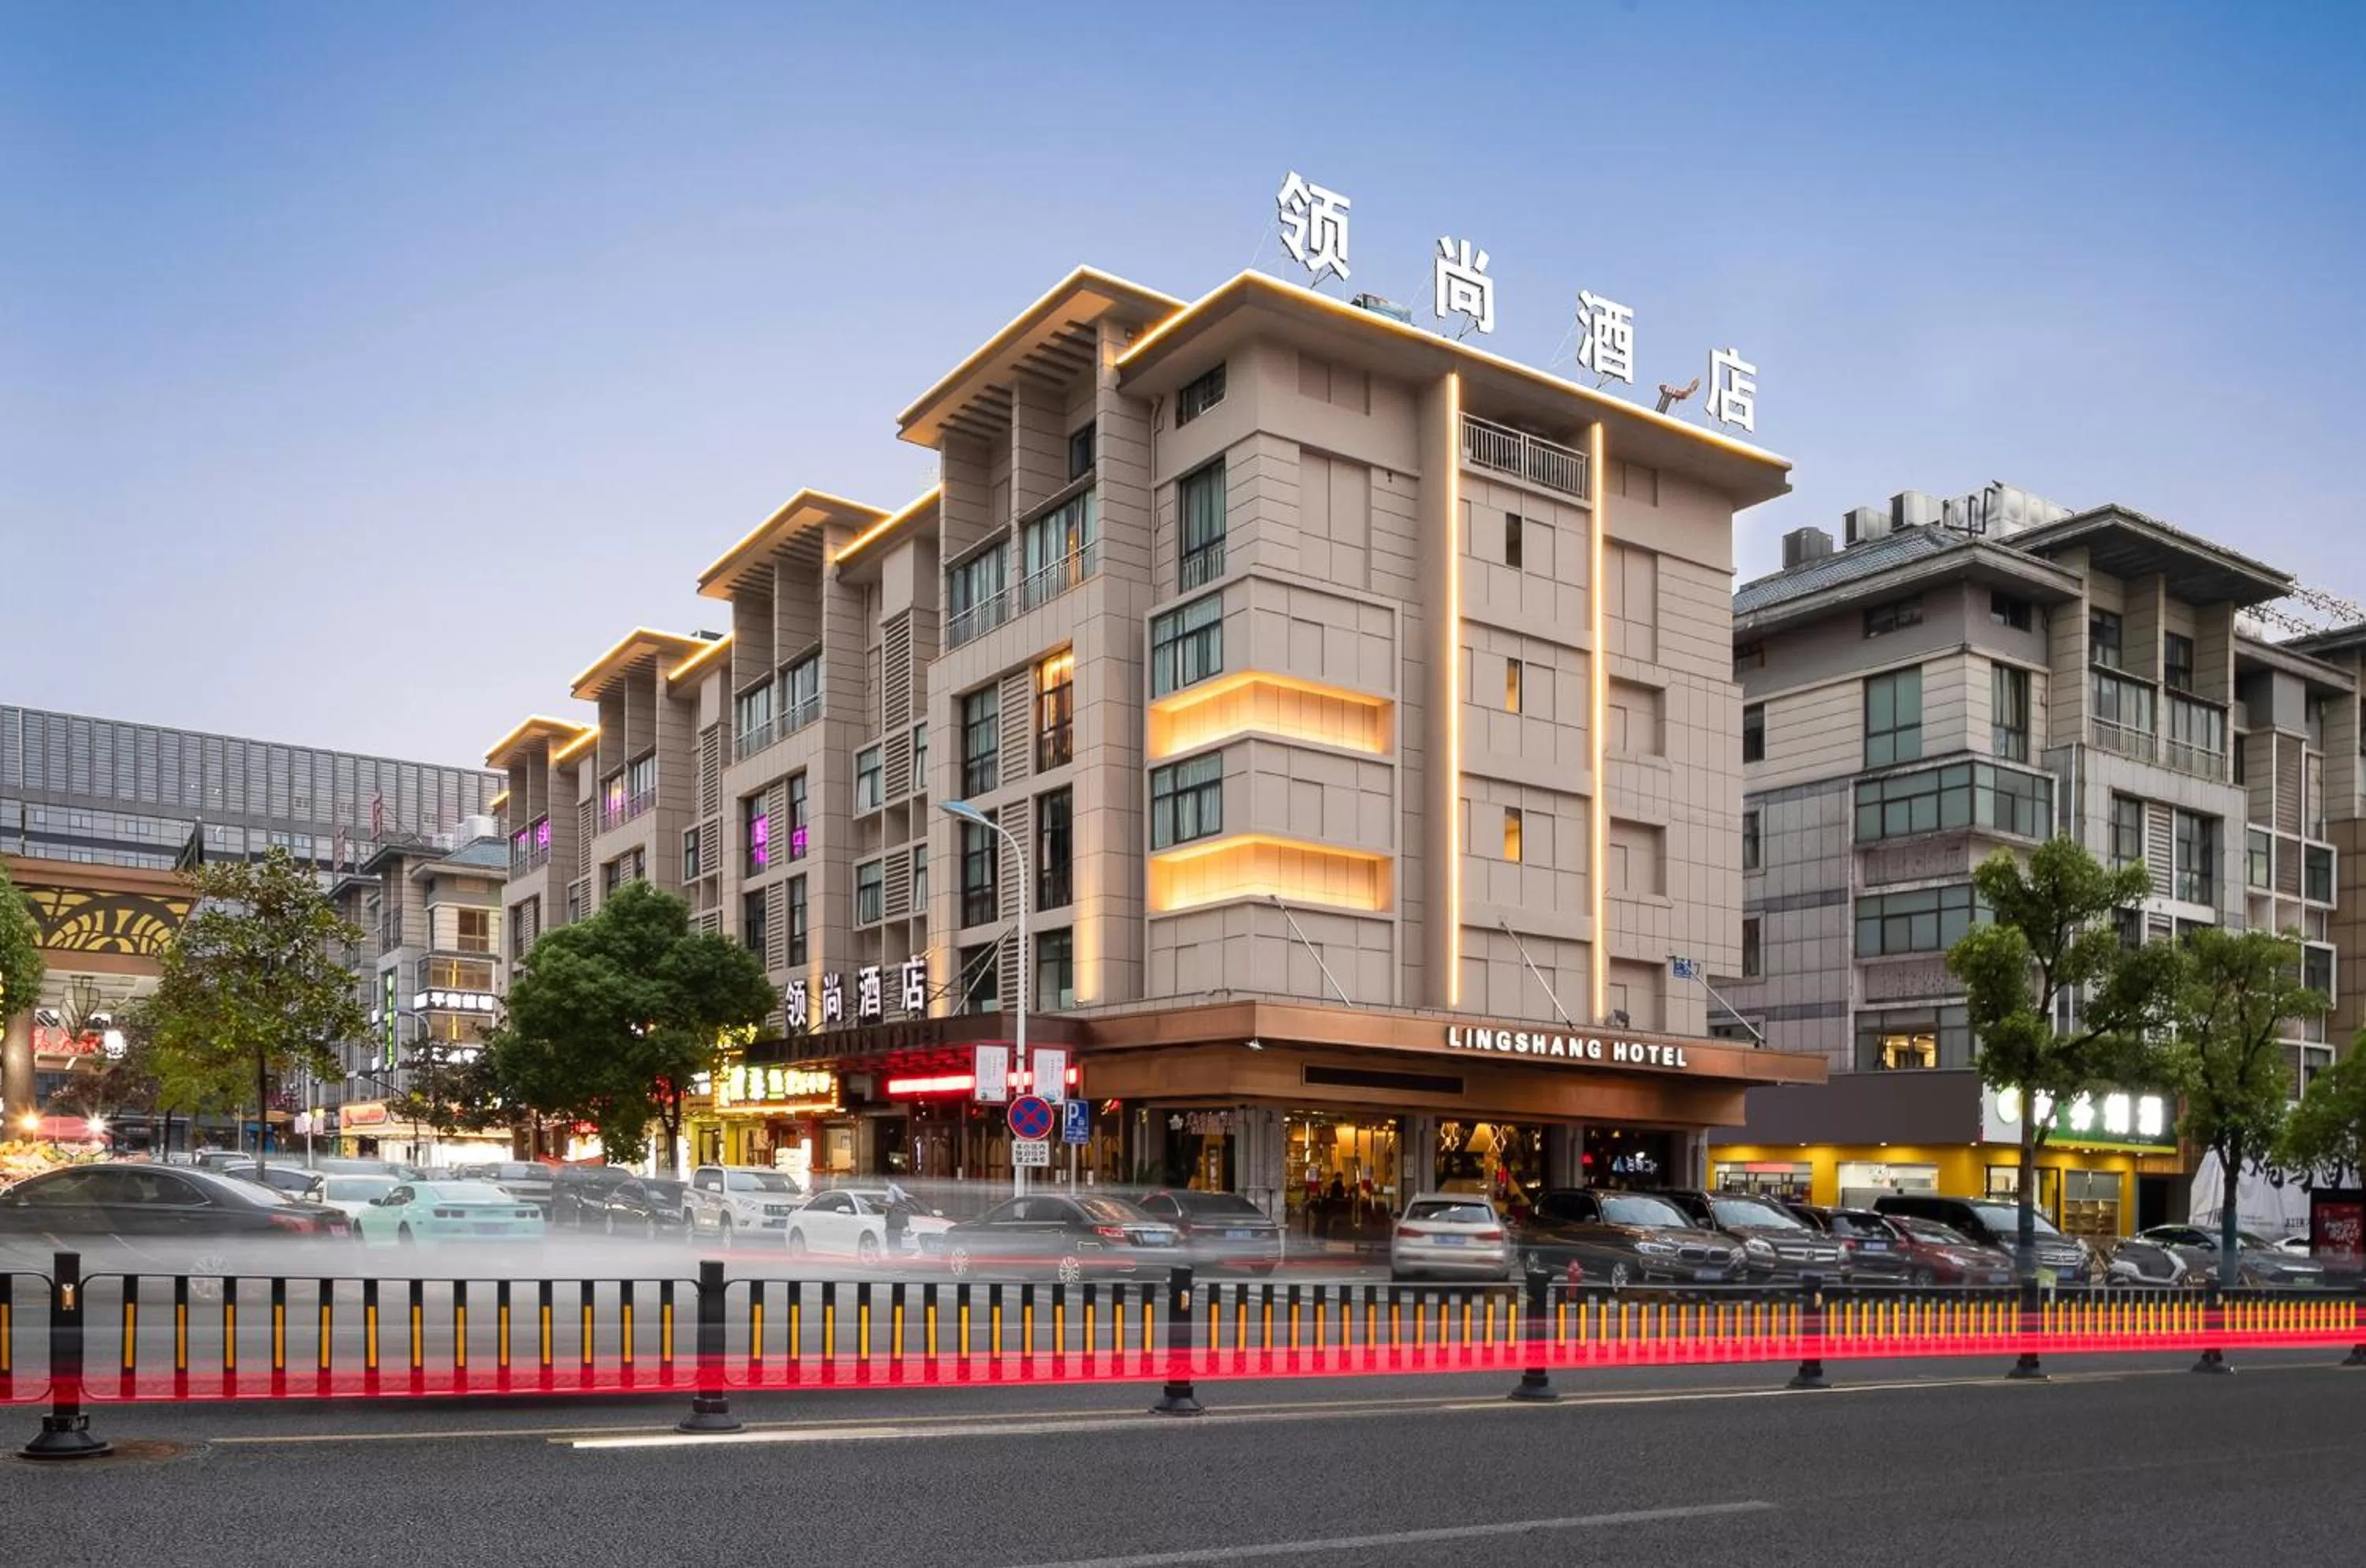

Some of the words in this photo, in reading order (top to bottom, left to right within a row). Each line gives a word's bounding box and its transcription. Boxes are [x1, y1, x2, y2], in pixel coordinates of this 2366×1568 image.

[1276, 170, 1756, 434] 领尚酒店
[786, 955, 925, 1026] 领尚酒店
[1449, 1027, 1602, 1058] LINGSHANG
[1614, 1043, 1687, 1066] HOTEL
[1068, 1103, 1079, 1126] P
